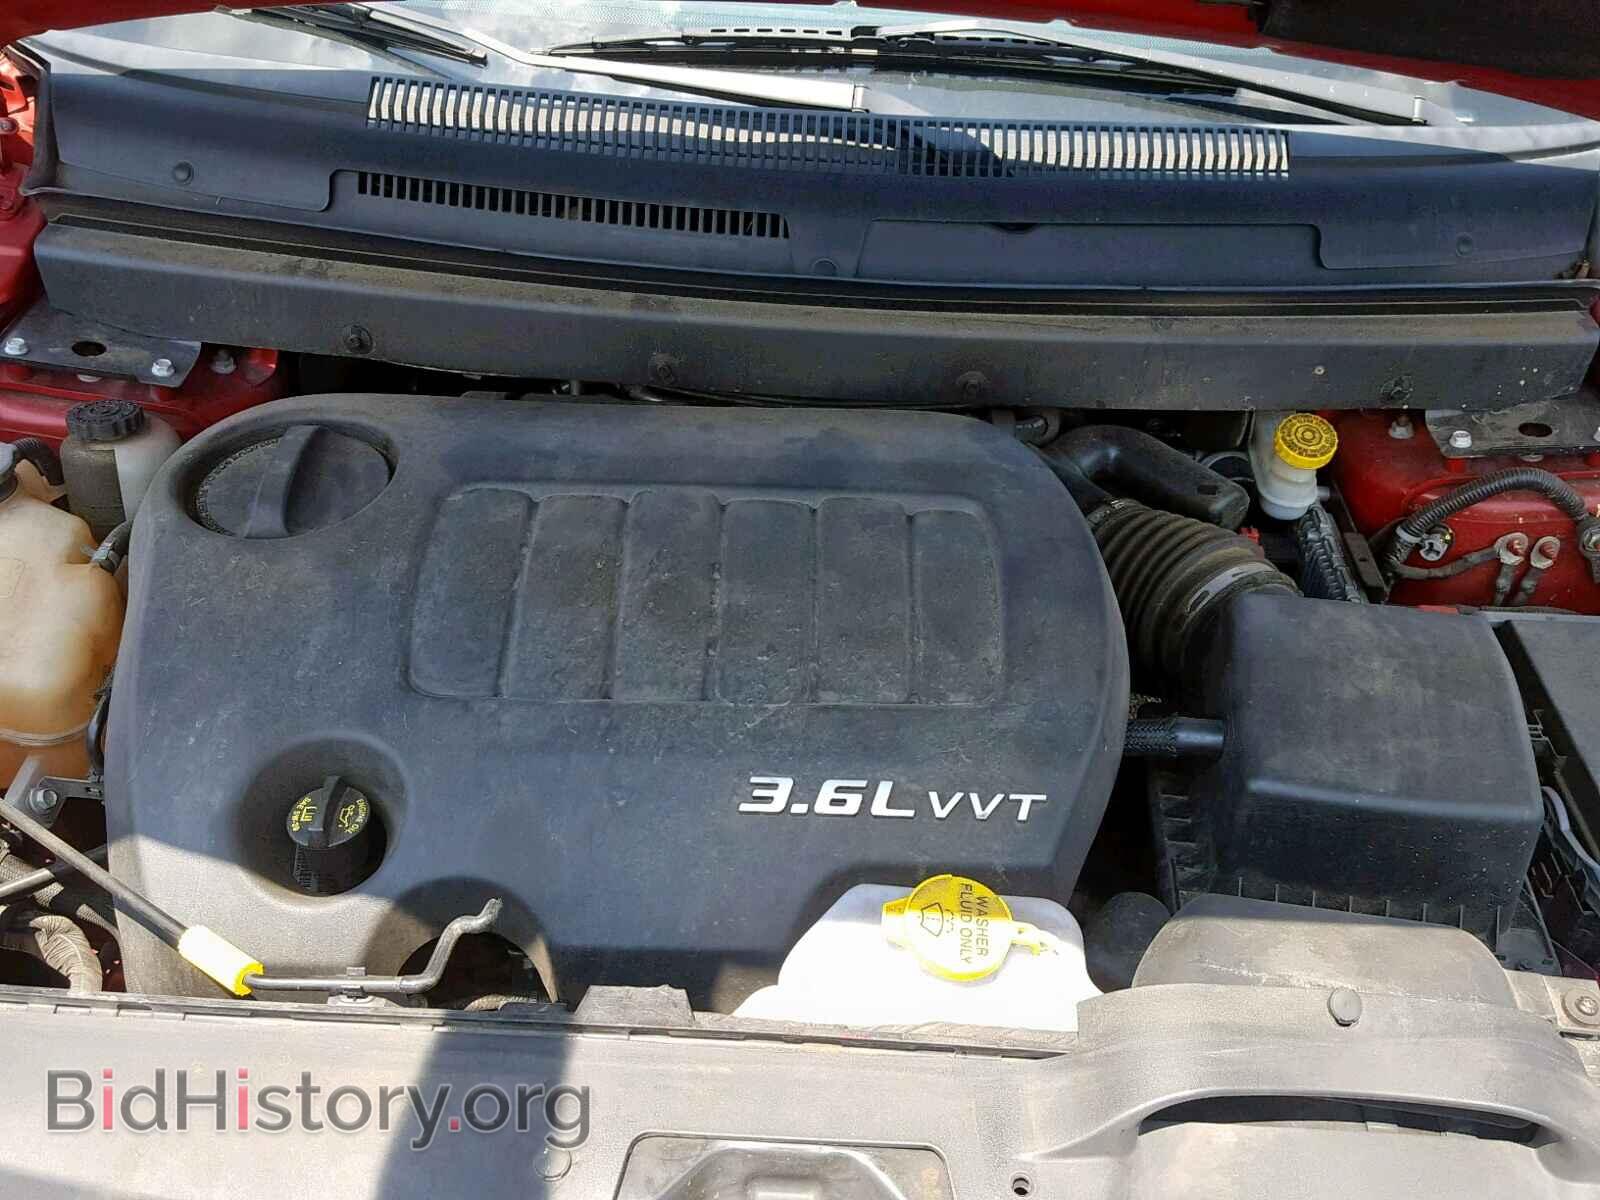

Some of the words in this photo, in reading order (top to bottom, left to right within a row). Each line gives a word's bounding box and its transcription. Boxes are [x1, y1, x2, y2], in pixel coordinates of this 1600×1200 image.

[738, 776, 916, 819] 3.6L
[927, 790, 1047, 821] VVT
[959, 882, 973, 923] FLUID
[959, 927, 974, 965] ONLY
[975, 895, 990, 957] WASHER
